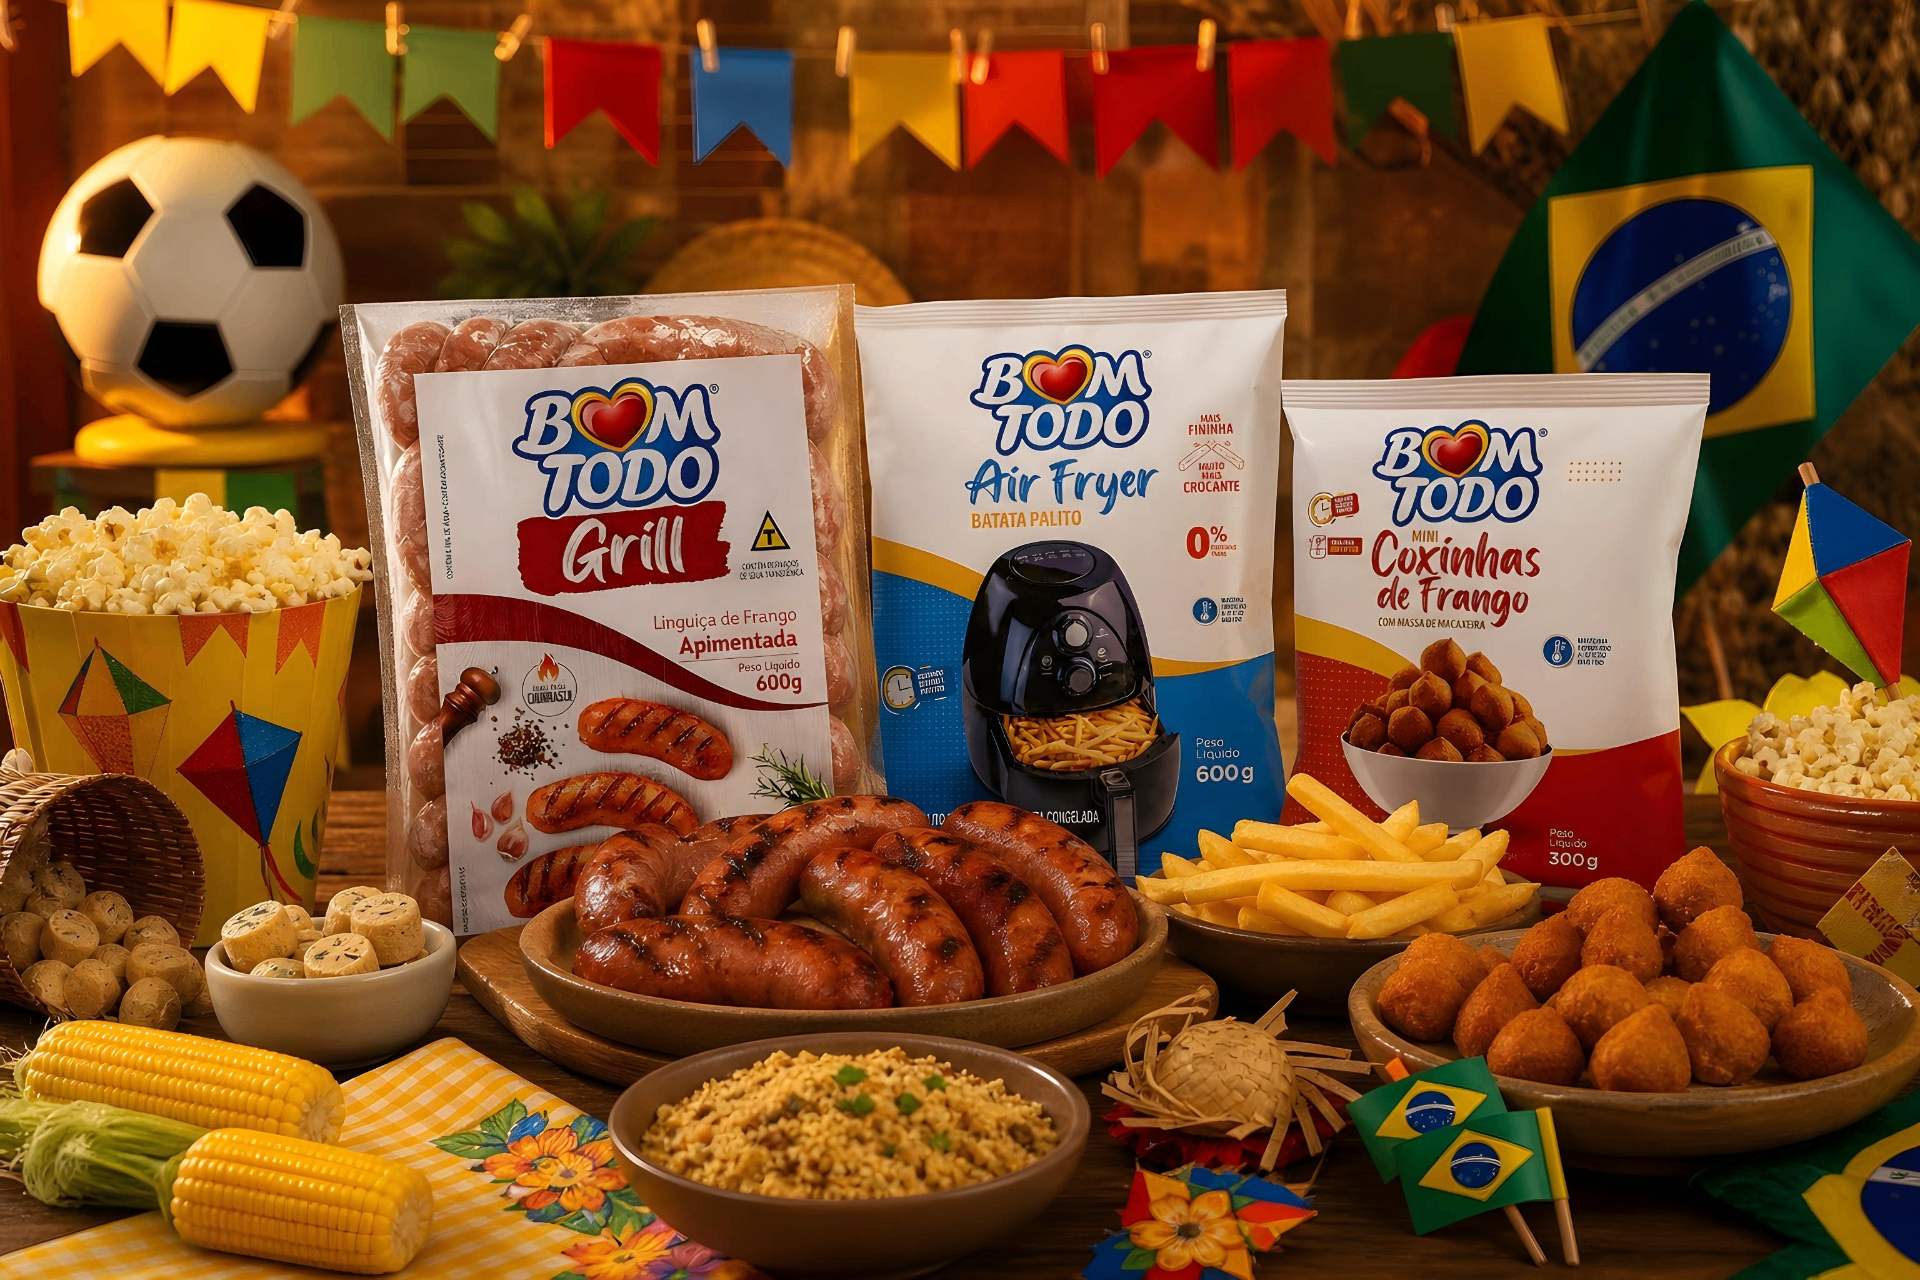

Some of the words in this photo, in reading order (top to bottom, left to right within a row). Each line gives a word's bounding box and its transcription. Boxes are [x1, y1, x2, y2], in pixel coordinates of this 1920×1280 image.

[995, 401, 1144, 450] TODO
[1188, 423, 1233, 435] FININHA
[542, 446, 713, 512] TODO
[965, 459, 1041, 505] Air
[1049, 459, 1159, 515] Fryer
[1183, 481, 1240, 493] CROCANTE
[1395, 476, 1534, 522] TODO
[971, 512, 1027, 529] BATATA
[1030, 510, 1082, 527] PALITO
[763, 529, 775, 545] T
[1411, 530, 1439, 543] MINI
[562, 515, 686, 584] Grill
[1371, 529, 1541, 580] Coxinhas
[1376, 576, 1410, 610] de
[1419, 576, 1529, 628] Frango
[653, 613, 717, 633] Linguiça
[720, 610, 740, 626] de
[744, 609, 797, 626] Frango
[1378, 617, 1396, 627] COM
[1426, 619, 1437, 628] DE
[679, 628, 798, 659] Apimentada
[738, 662, 762, 672] Peso
[756, 673, 802, 694] 600g
[1196, 737, 1224, 748] Peso
